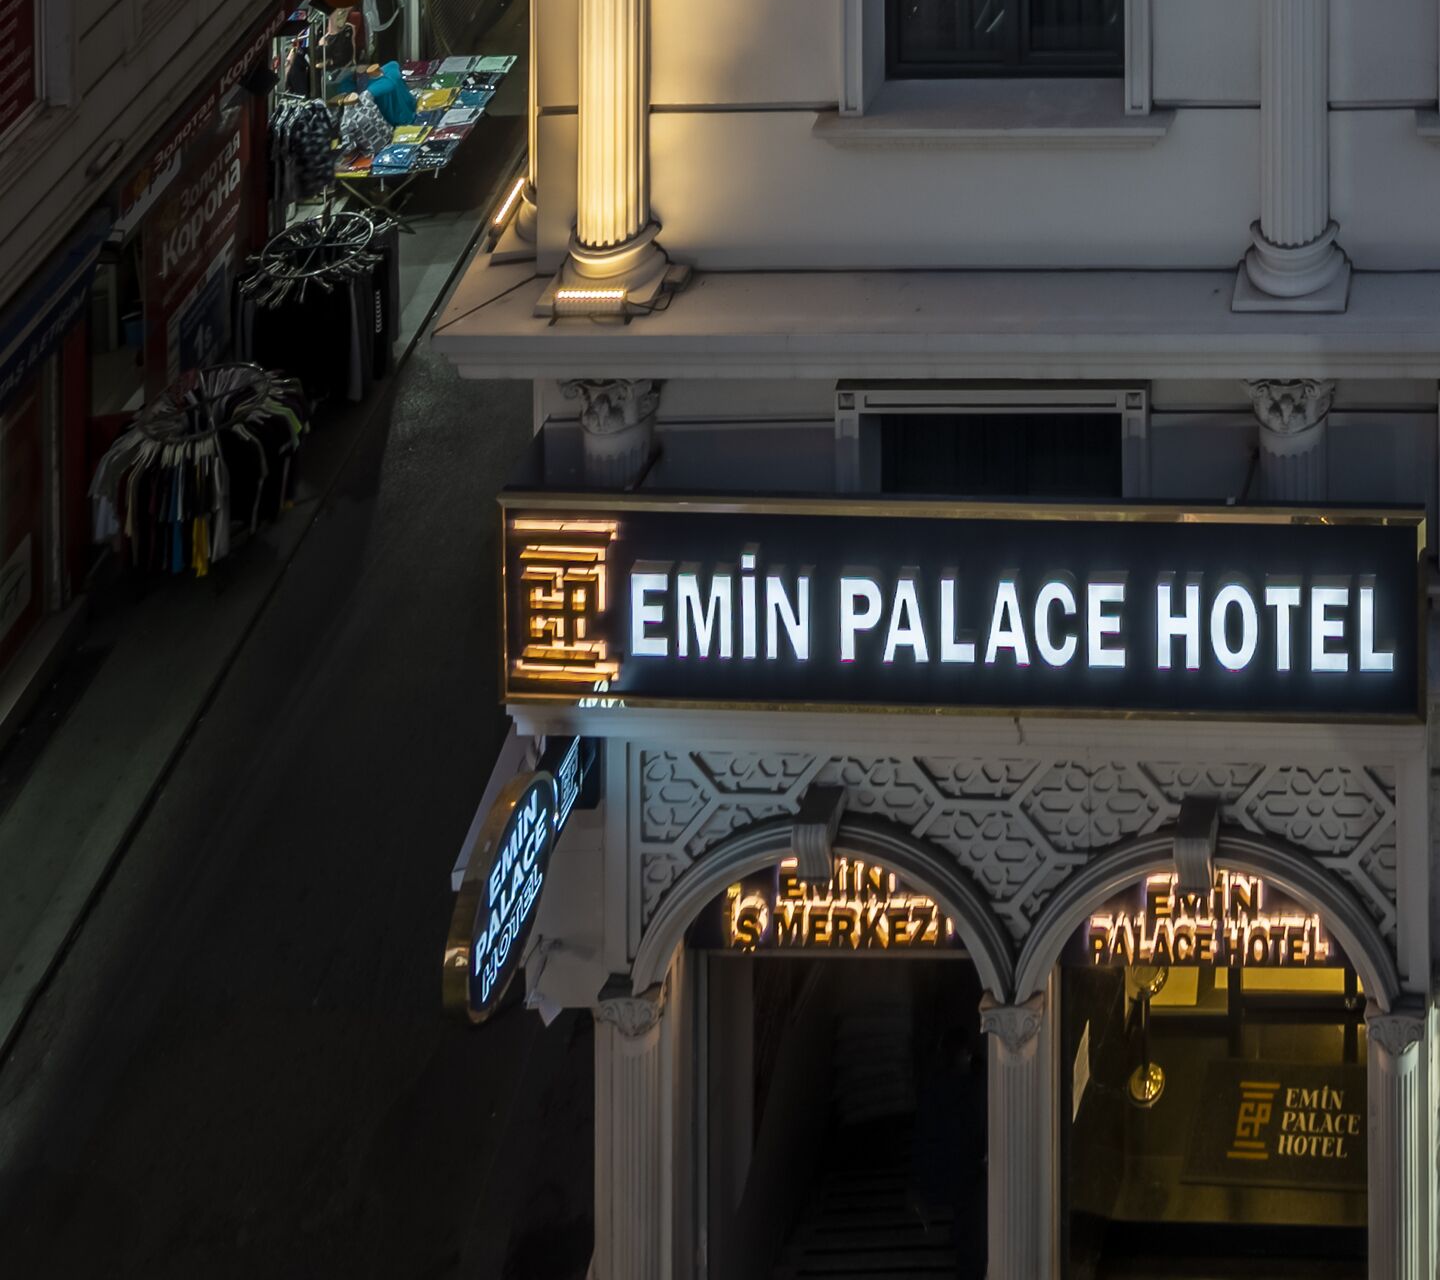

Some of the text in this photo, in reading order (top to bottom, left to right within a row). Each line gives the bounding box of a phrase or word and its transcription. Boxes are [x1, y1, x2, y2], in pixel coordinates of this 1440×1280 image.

[153, 94, 215, 173] Золотая
[220, 9, 285, 95] Корона
[159, 158, 241, 279] Корона
[179, 130, 240, 220] Золотая
[630, 553, 1394, 673] EMİN PALACE HOTEL
[474, 807, 547, 977] PALACE
[488, 788, 538, 908] EMİN
[480, 863, 543, 1005] HOTEL
[1089, 915, 1329, 965] PALACE HOTEL
[1277, 1134, 1348, 1159] HOTEL
[1281, 1110, 1361, 1135] PALACE
[1285, 1083, 1345, 1111] EMİN
